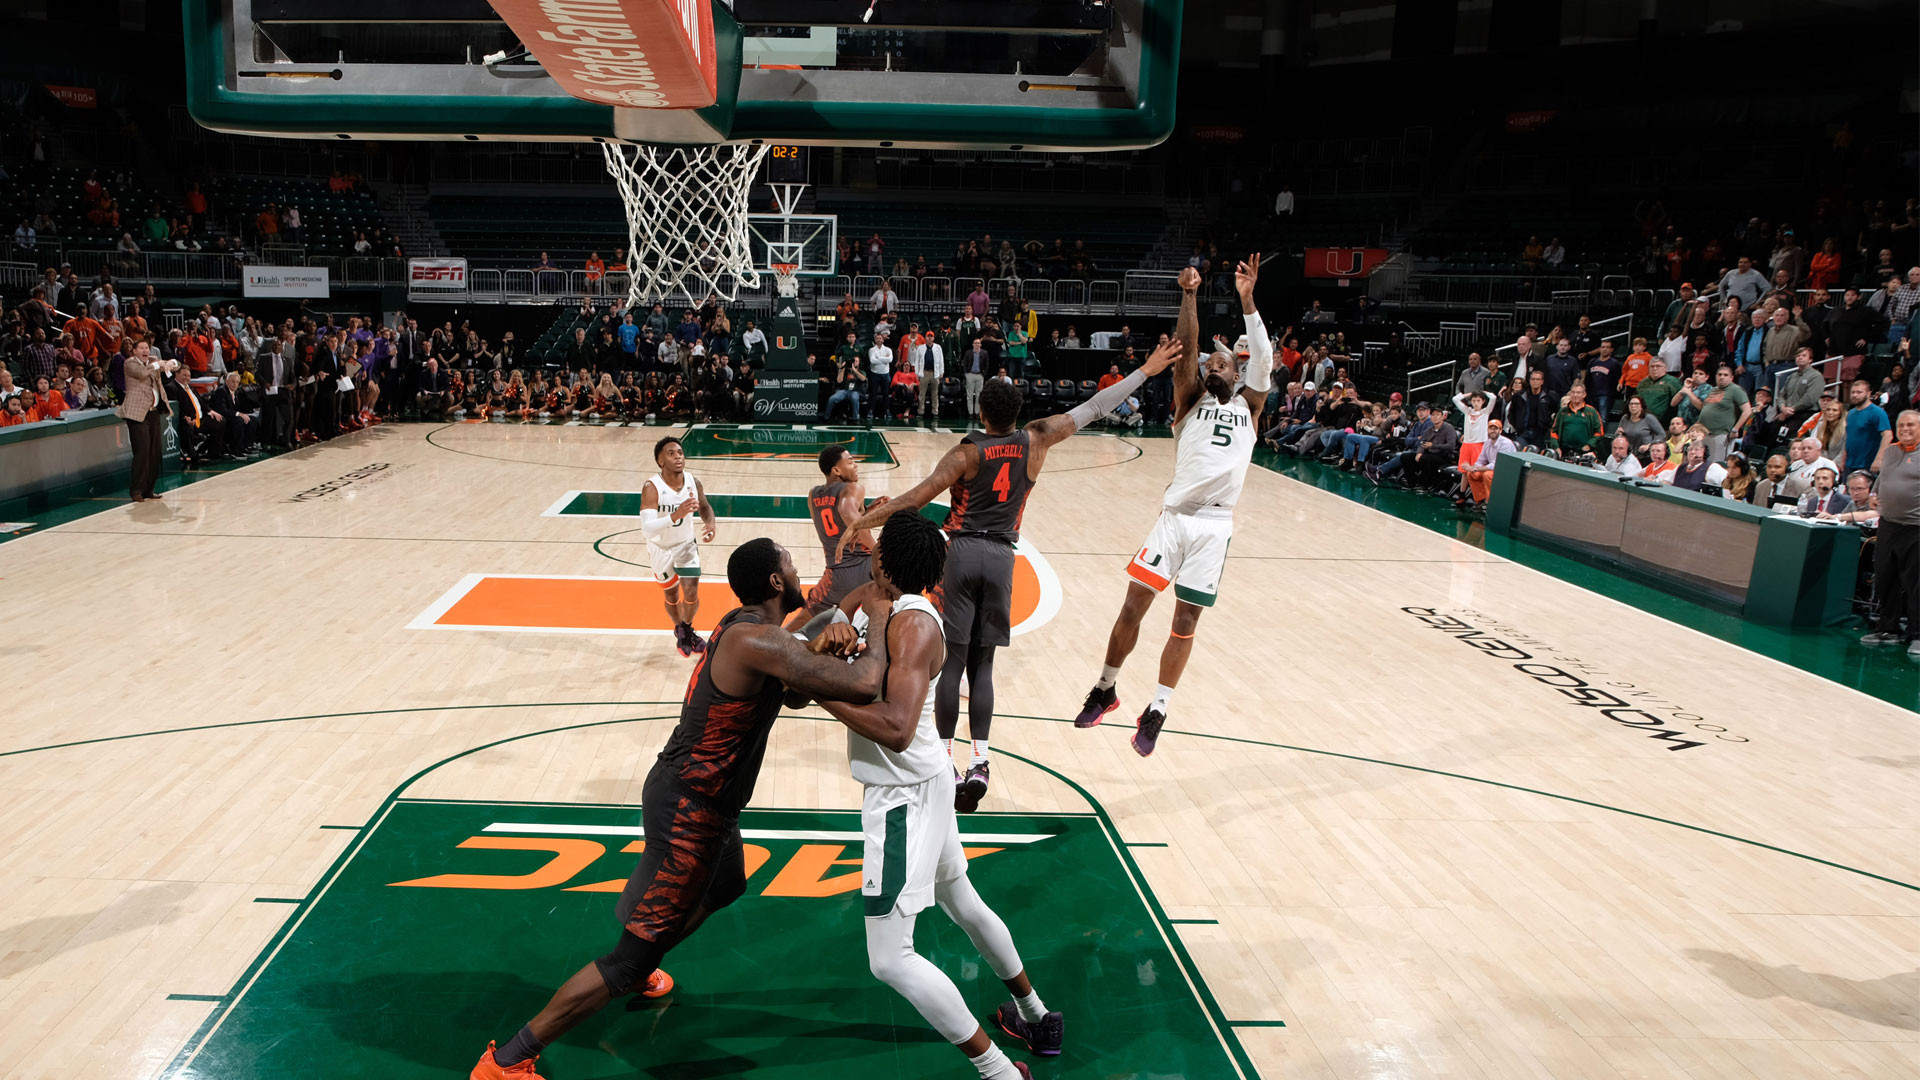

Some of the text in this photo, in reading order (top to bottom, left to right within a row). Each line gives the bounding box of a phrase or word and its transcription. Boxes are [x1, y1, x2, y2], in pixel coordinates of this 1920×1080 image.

[412, 266, 464, 281] ESPN
[1211, 423, 1234, 448] 5
[984, 444, 1023, 461] MITCHELL
[992, 462, 1011, 503] 4
[820, 507, 840, 538] 0
